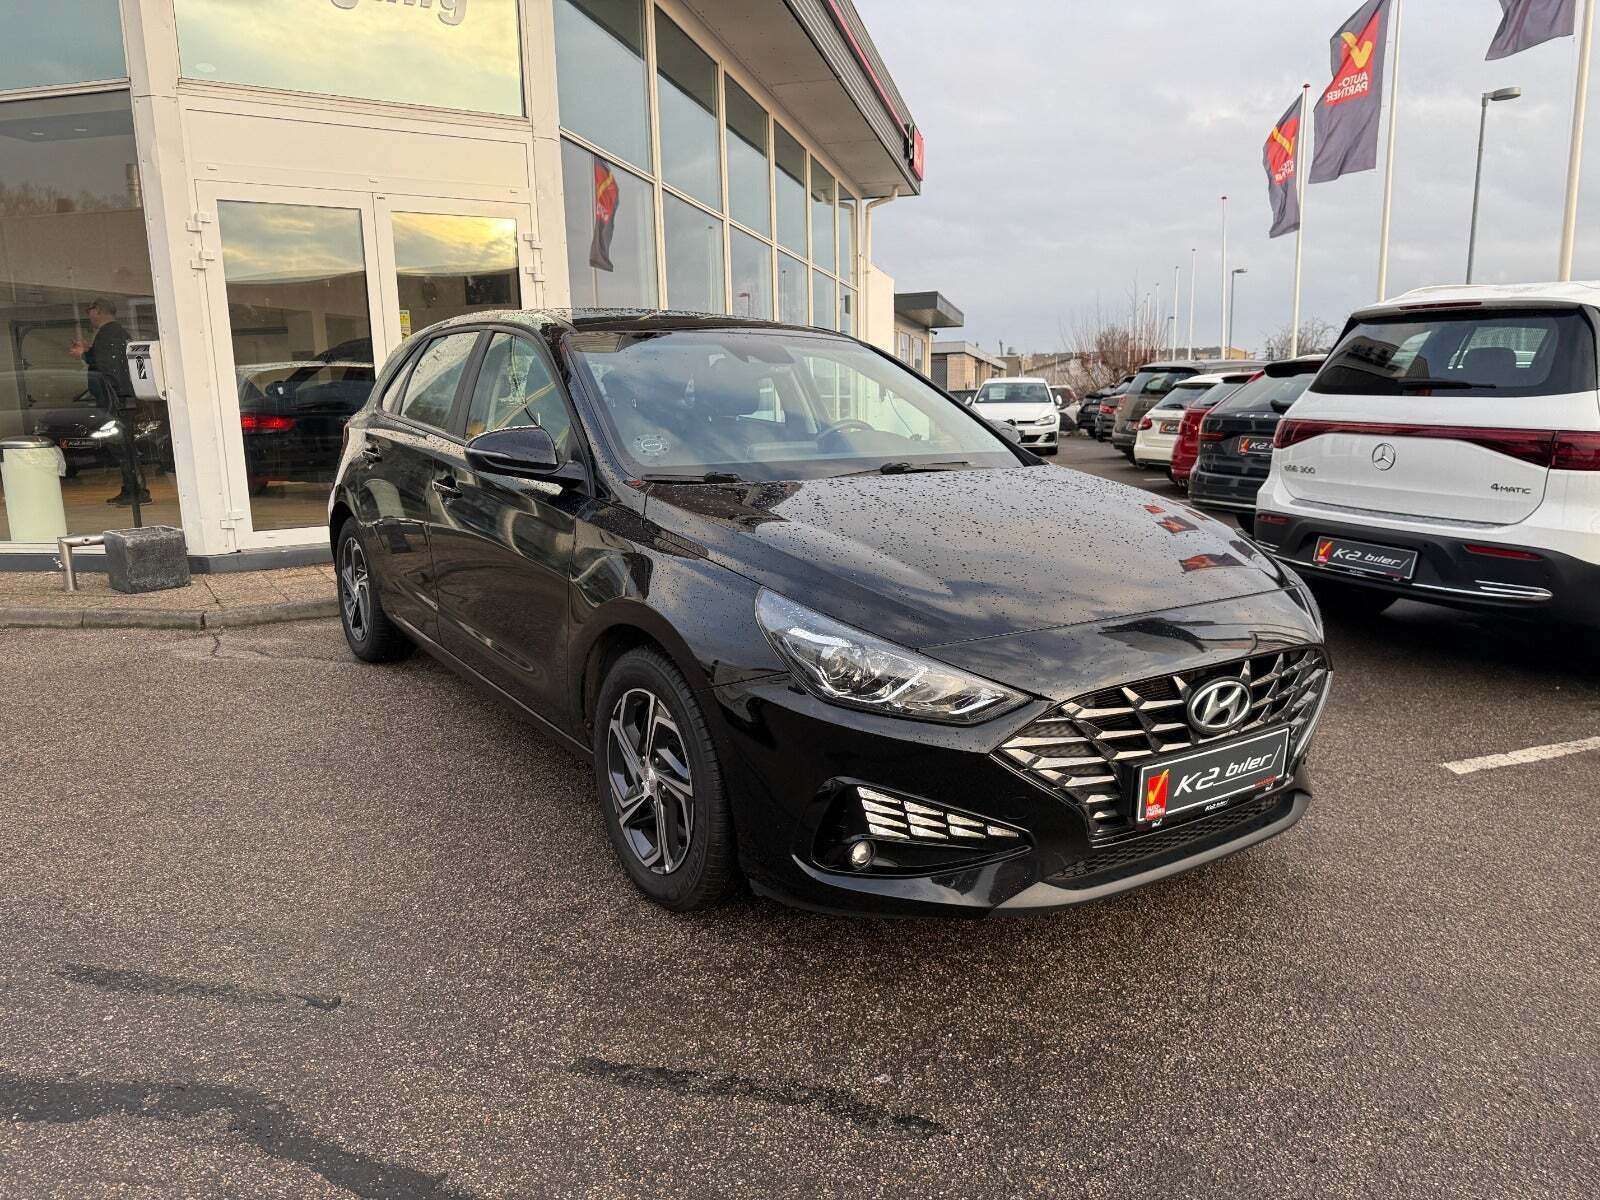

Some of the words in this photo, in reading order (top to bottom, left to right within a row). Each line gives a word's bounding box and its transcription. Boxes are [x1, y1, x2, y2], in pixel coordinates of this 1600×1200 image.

[1249, 442, 1268, 450] K2
[1490, 483, 1531, 494] 4MATIC
[1332, 548, 1362, 561] K2
[1364, 553, 1402, 566] biler
[1174, 766, 1220, 797] K2
[1225, 753, 1272, 777] biler
